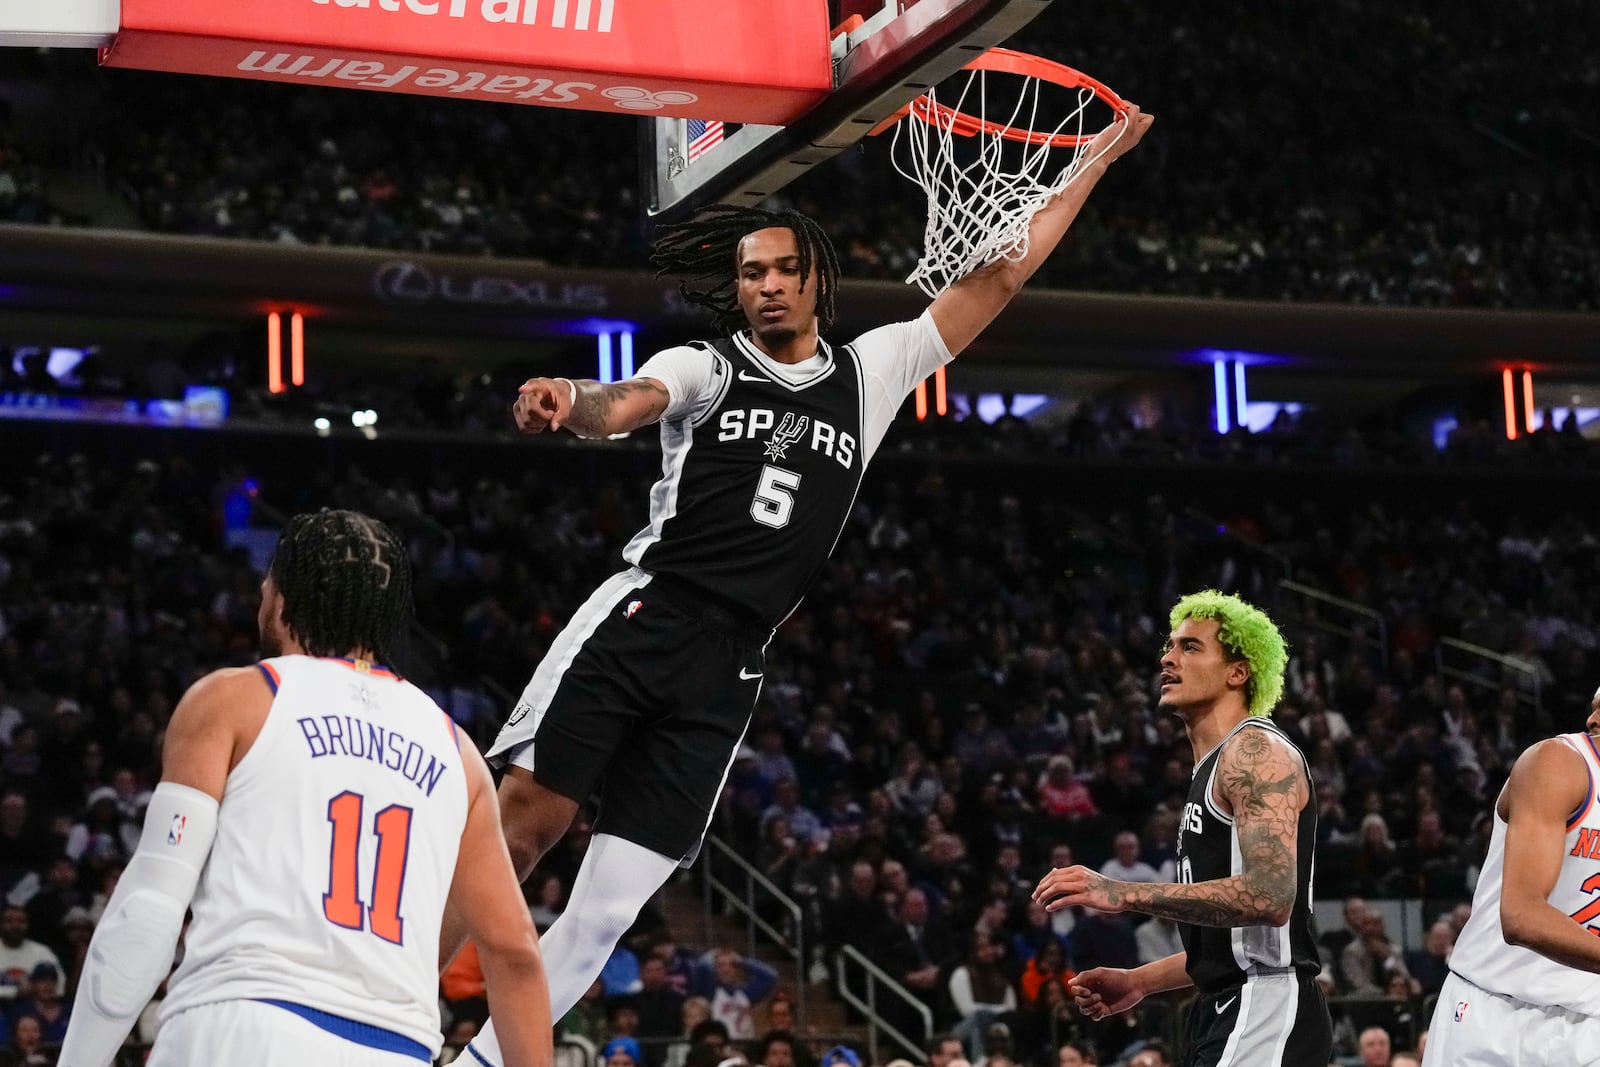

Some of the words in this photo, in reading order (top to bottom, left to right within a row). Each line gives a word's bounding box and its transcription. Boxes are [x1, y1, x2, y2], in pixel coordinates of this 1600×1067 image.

[236, 50, 597, 103] StateFarm
[440, 275, 608, 310] LEXUS
[718, 408, 856, 470] SPURS
[750, 463, 802, 530] 5
[297, 715, 447, 797] BRUNSON
[322, 789, 413, 946] 11
